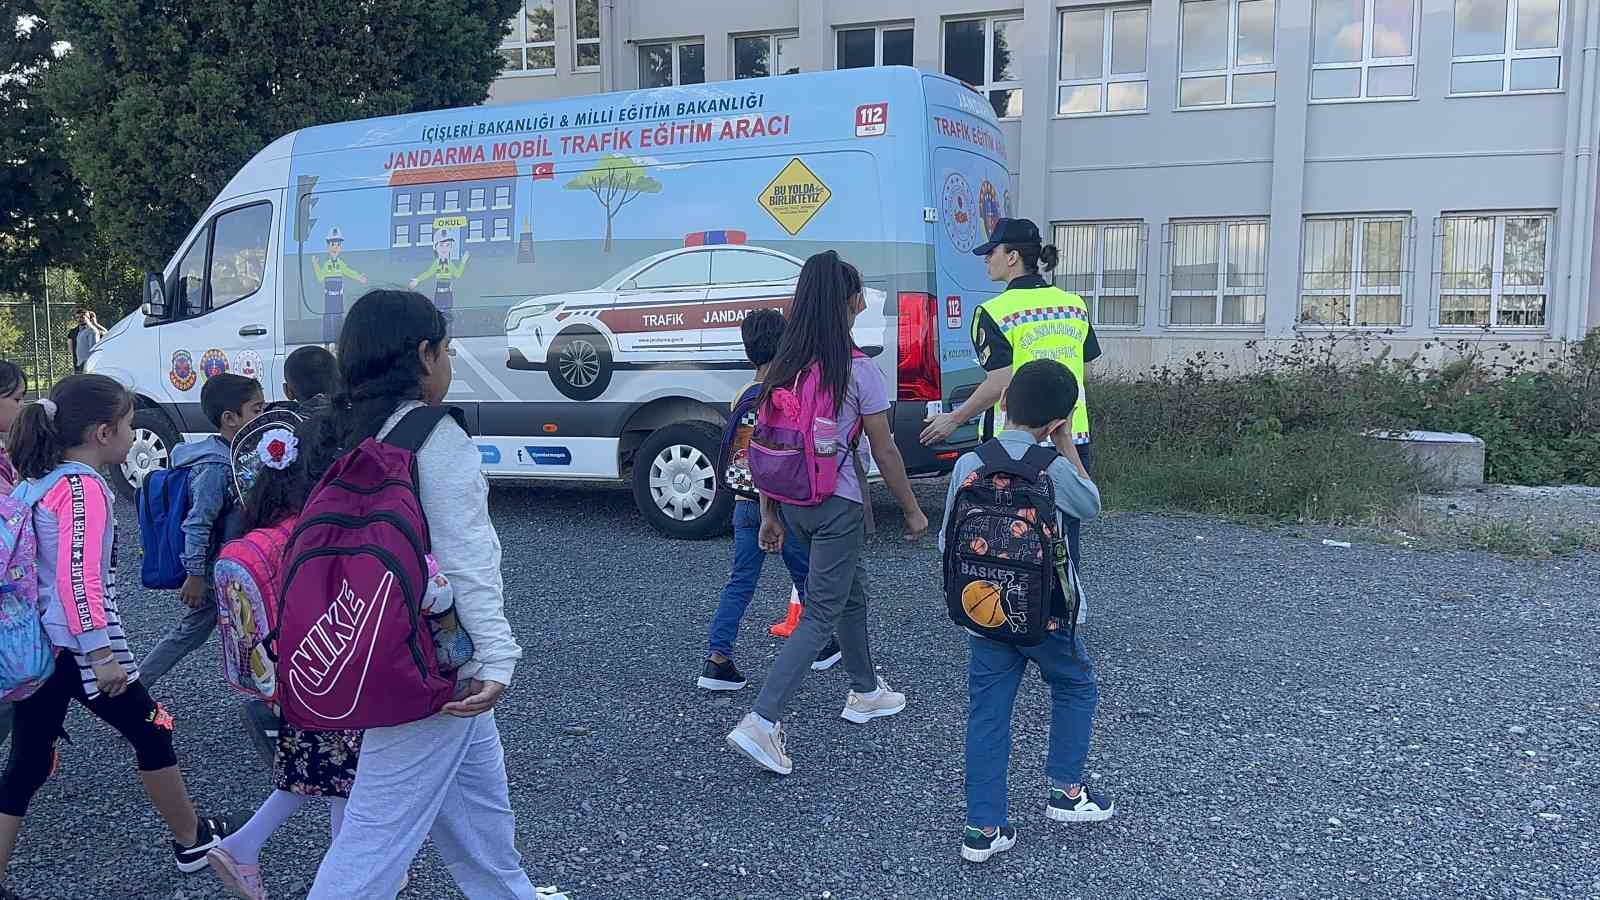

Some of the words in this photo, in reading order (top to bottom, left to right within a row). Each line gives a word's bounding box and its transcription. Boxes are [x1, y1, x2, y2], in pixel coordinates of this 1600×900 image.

[422, 120, 474, 144] İÇİŞLERİ
[478, 113, 554, 135] BAKANLIĞI
[560, 114, 569, 127] &
[575, 106, 613, 126] MİLLİ
[619, 101, 670, 122] EĞİTİM
[677, 91, 764, 116] BAKANLIĞI
[860, 107, 883, 124] 112
[384, 144, 485, 170] JANDARMA
[492, 135, 553, 161] MOBİL
[560, 127, 632, 154] TRAFİK
[639, 119, 713, 148] EĞİTİM
[719, 115, 790, 141] ARACI
[774, 184, 786, 196] BU
[787, 183, 815, 195] YOLDA
[642, 313, 685, 327] TRAFİK
[703, 307, 784, 324] JANDAI
[948, 300, 960, 316] 112
[72, 482, 84, 500] LATE
[73, 501, 85, 519] TOO
[72, 519, 85, 548] NEVER
[71, 562, 84, 583] LATE
[73, 583, 86, 603] TOO
[77, 602, 93, 632] NEVER
[291, 578, 365, 687] NIKE
